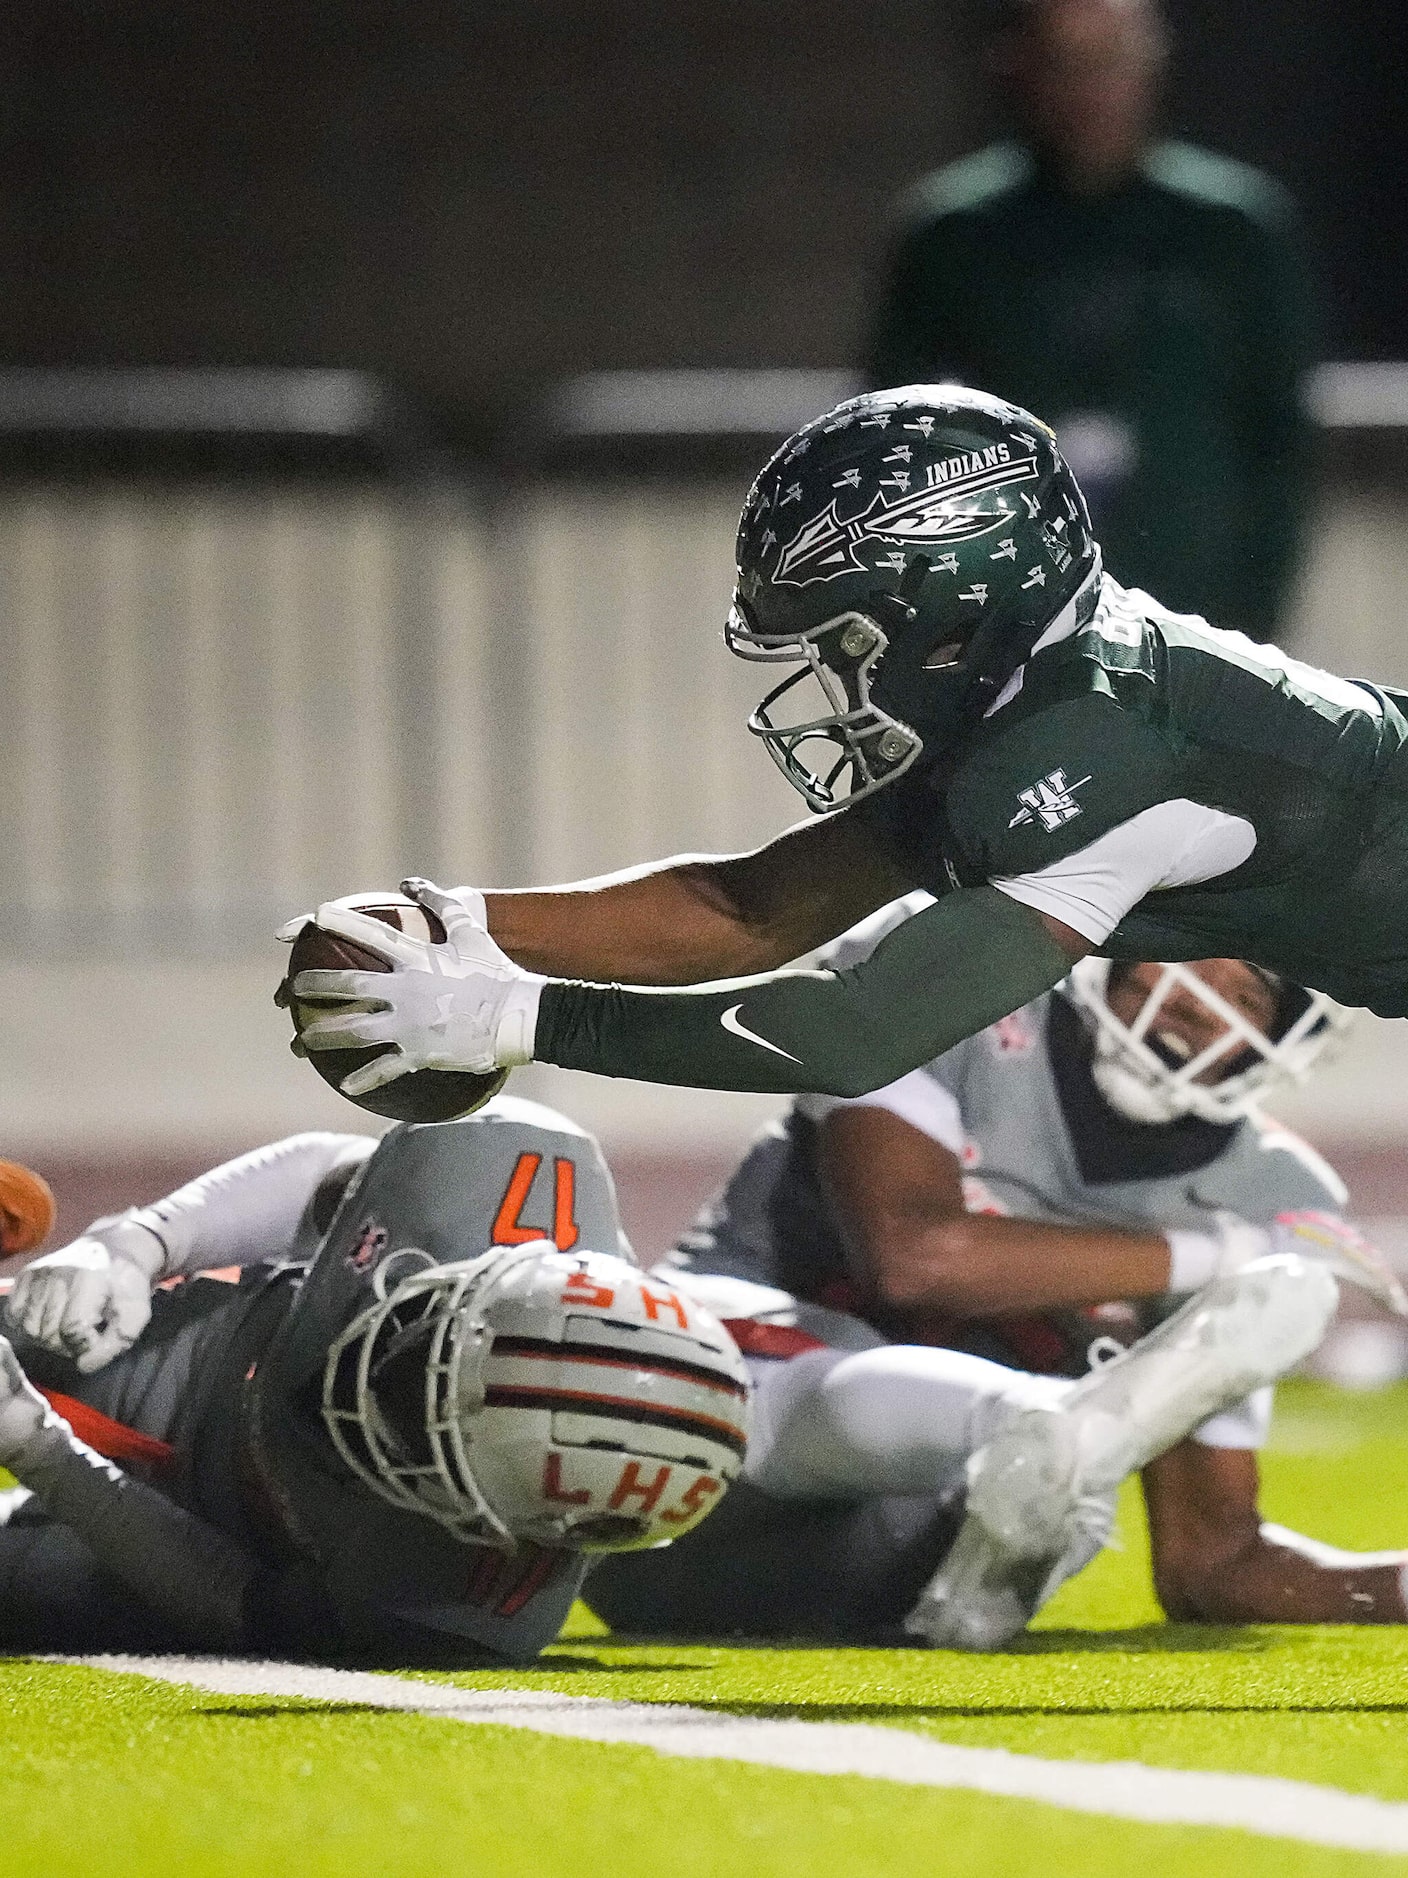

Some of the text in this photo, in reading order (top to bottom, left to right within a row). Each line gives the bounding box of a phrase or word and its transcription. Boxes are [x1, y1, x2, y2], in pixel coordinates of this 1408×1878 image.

[926, 442, 1011, 487] INDIANS
[488, 1152, 579, 1252] 17
[543, 1453, 720, 1523] LHS
